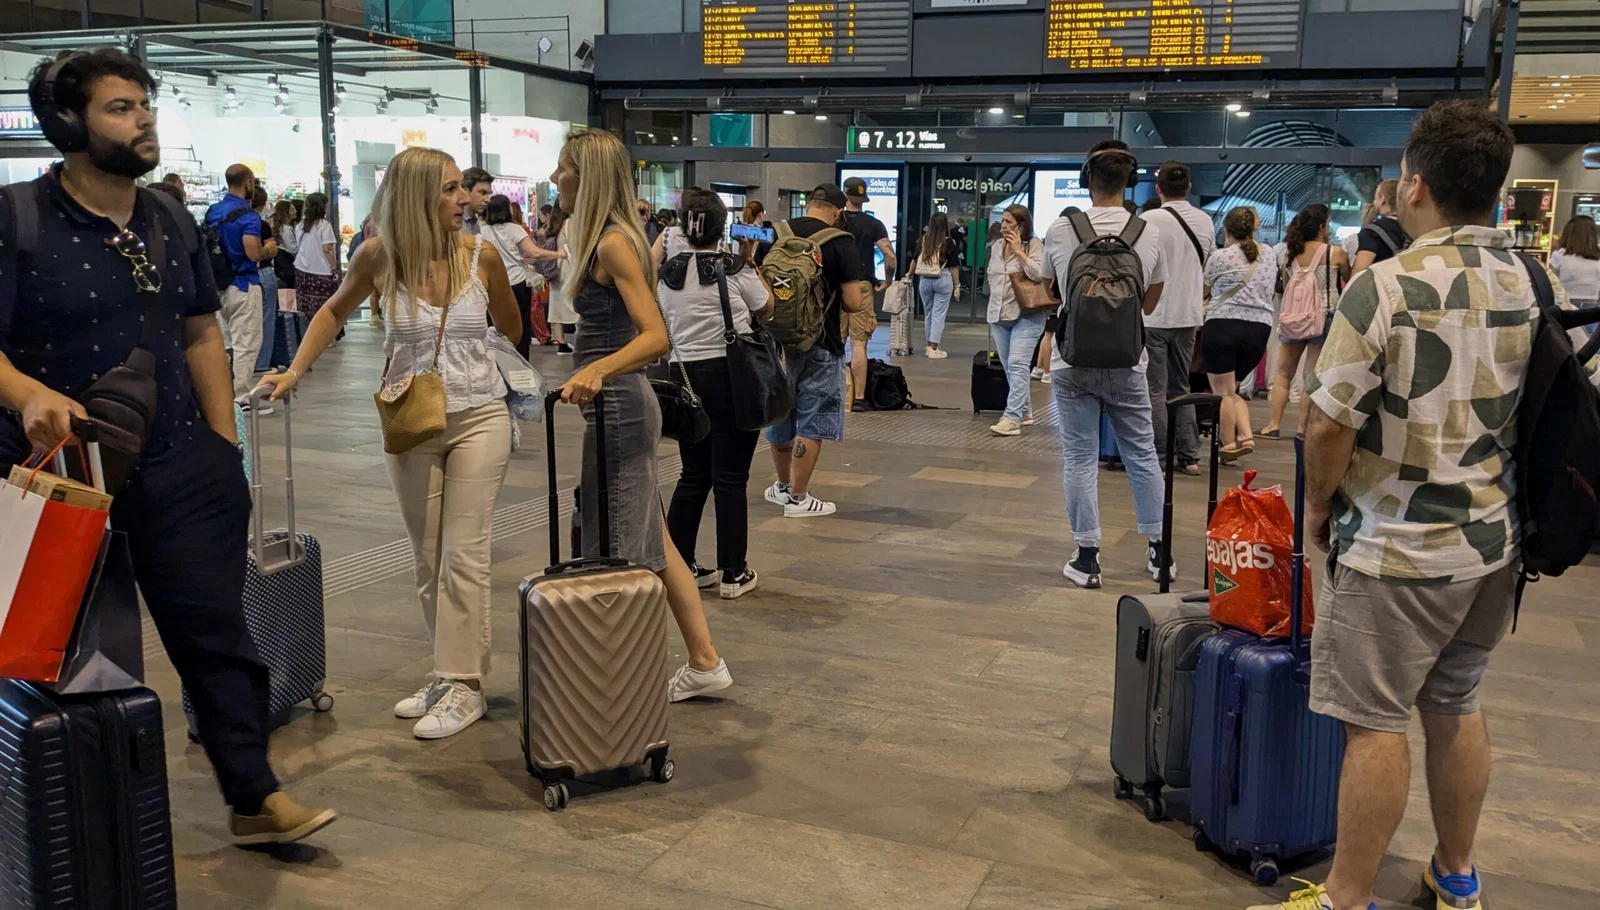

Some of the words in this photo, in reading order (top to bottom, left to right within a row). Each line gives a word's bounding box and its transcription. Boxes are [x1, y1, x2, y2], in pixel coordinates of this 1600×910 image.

[1092, 58, 1123, 68] BILLETE
[1126, 58, 1141, 67] CON
[874, 131, 884, 149] 7
[886, 140, 893, 148] a
[896, 131, 916, 149] 12
[870, 179, 886, 187] Salas
[888, 179, 896, 187] de
[867, 186, 896, 194] tworking
[937, 205, 948, 214] 10
